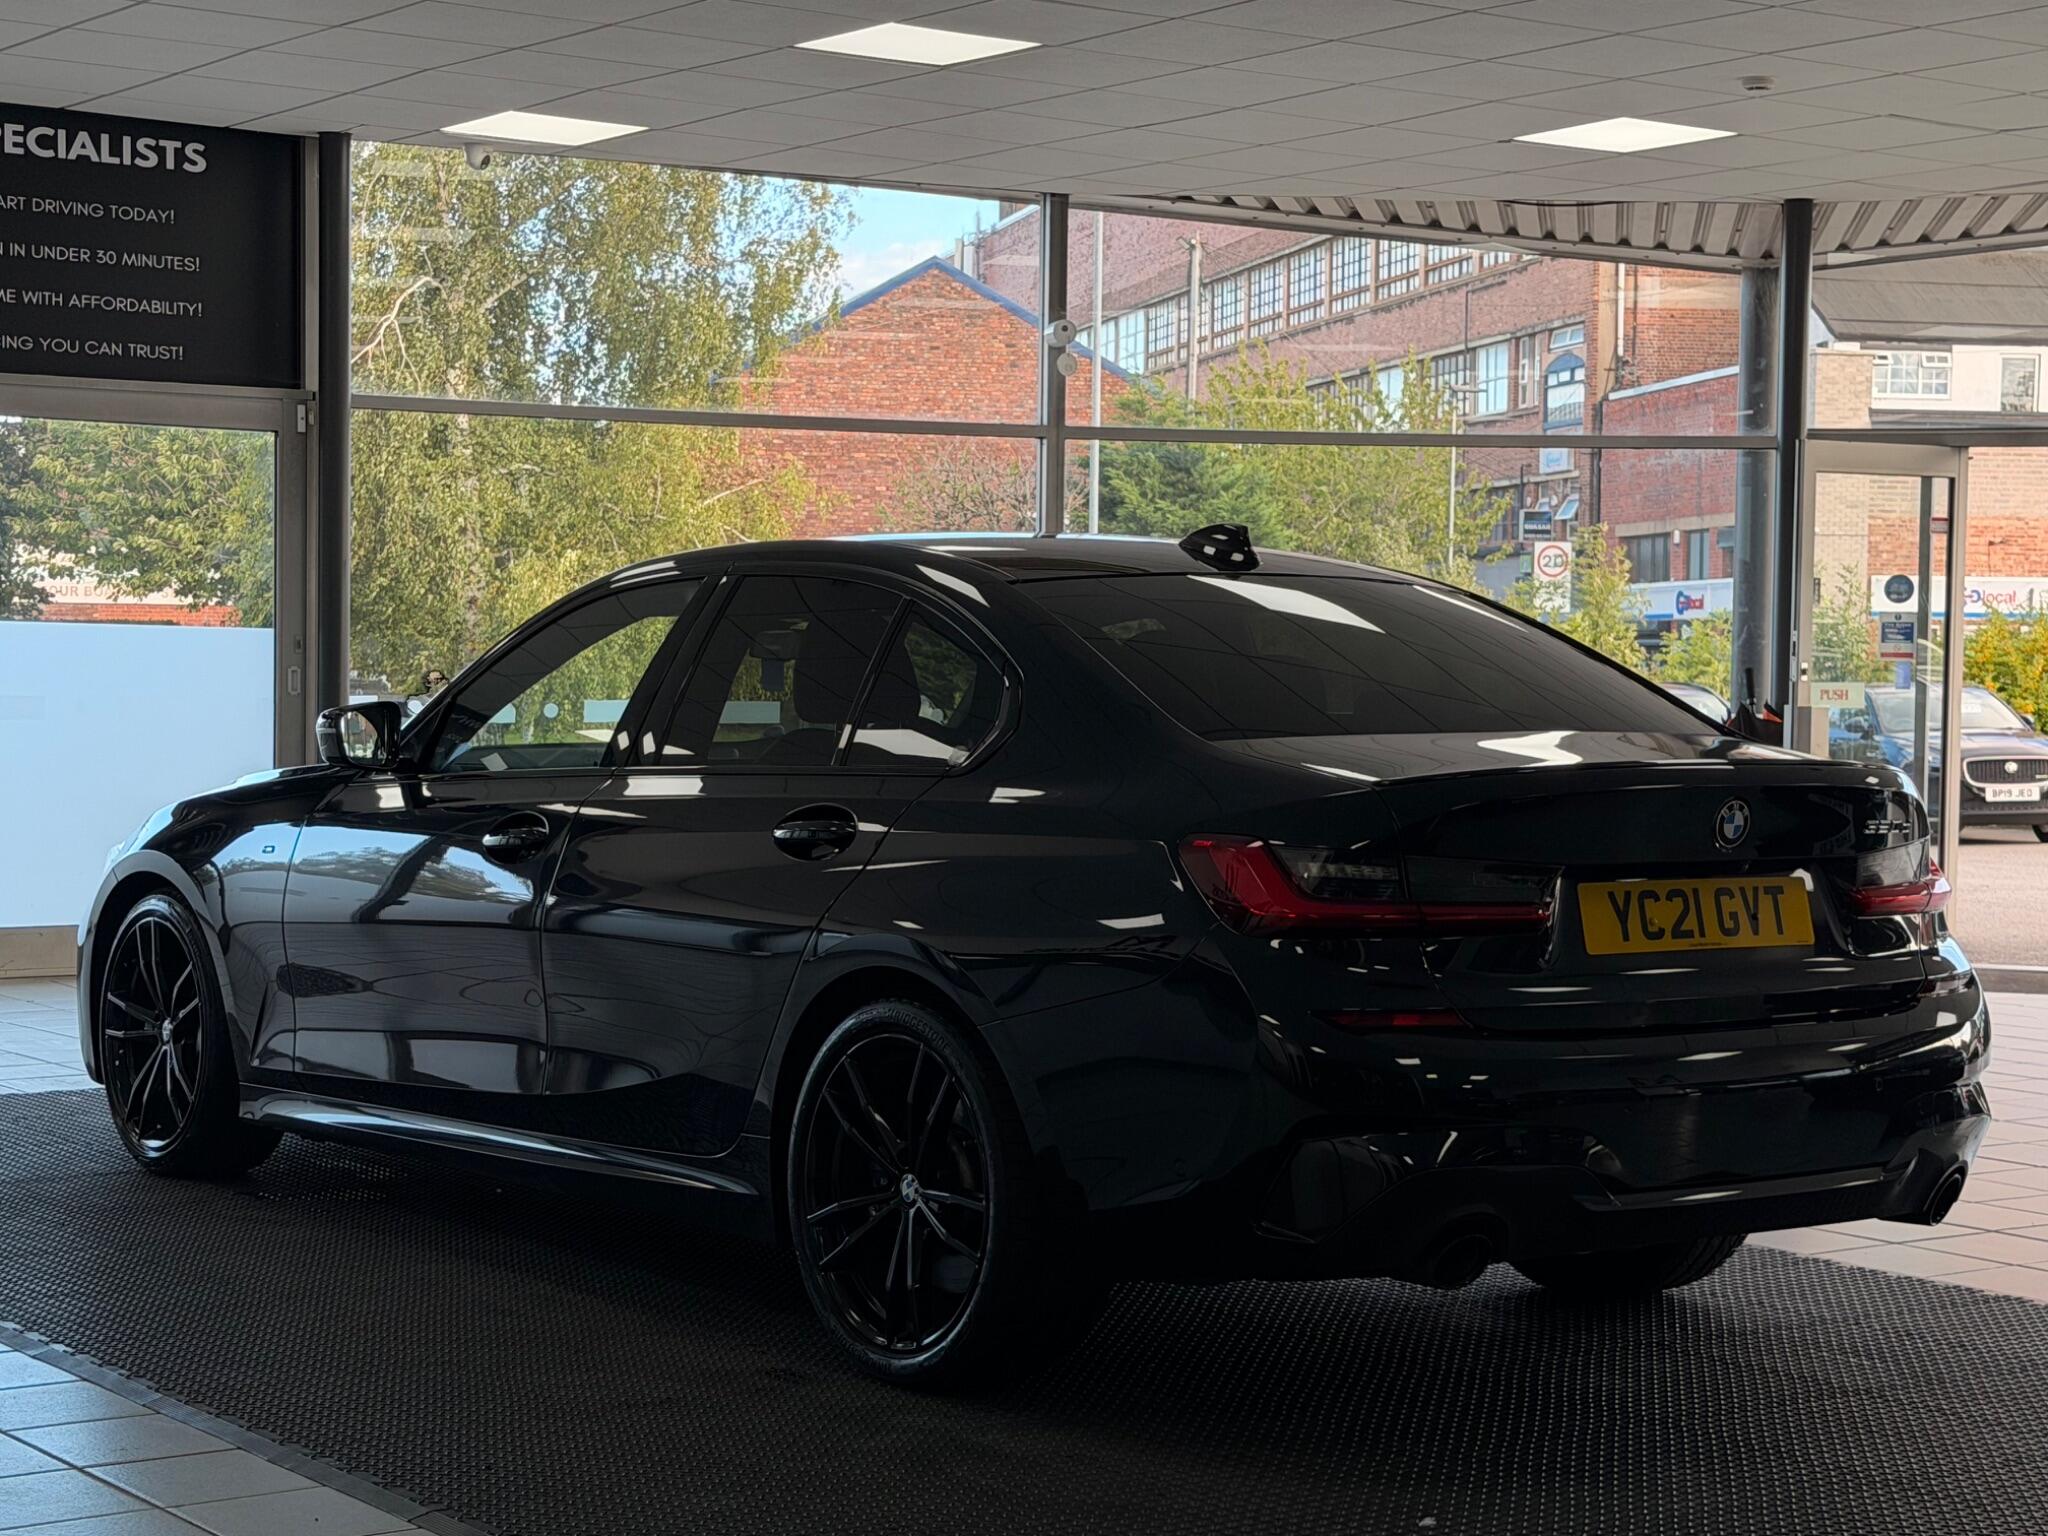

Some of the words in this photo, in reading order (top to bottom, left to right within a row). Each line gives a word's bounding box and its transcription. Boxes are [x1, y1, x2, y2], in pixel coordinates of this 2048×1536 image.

[0, 123, 207, 173] ECIALISTS
[32, 198, 104, 217] DRIVING
[109, 205, 175, 224] TODAY!
[9, 242, 26, 257] IN
[31, 244, 90, 262] UNDER
[96, 250, 117, 264] 30
[121, 253, 200, 271] MINUTES!
[22, 290, 63, 307] WITH
[68, 294, 202, 316] AFFORDABILITY!
[0, 335, 34, 350] ING
[39, 337, 79, 353] YOU
[84, 341, 122, 356] CAN
[128, 343, 183, 360] TRUST!
[1820, 688, 1849, 701] PUSH
[1607, 887, 1706, 942] YC21
[1714, 885, 1784, 938] GVT
